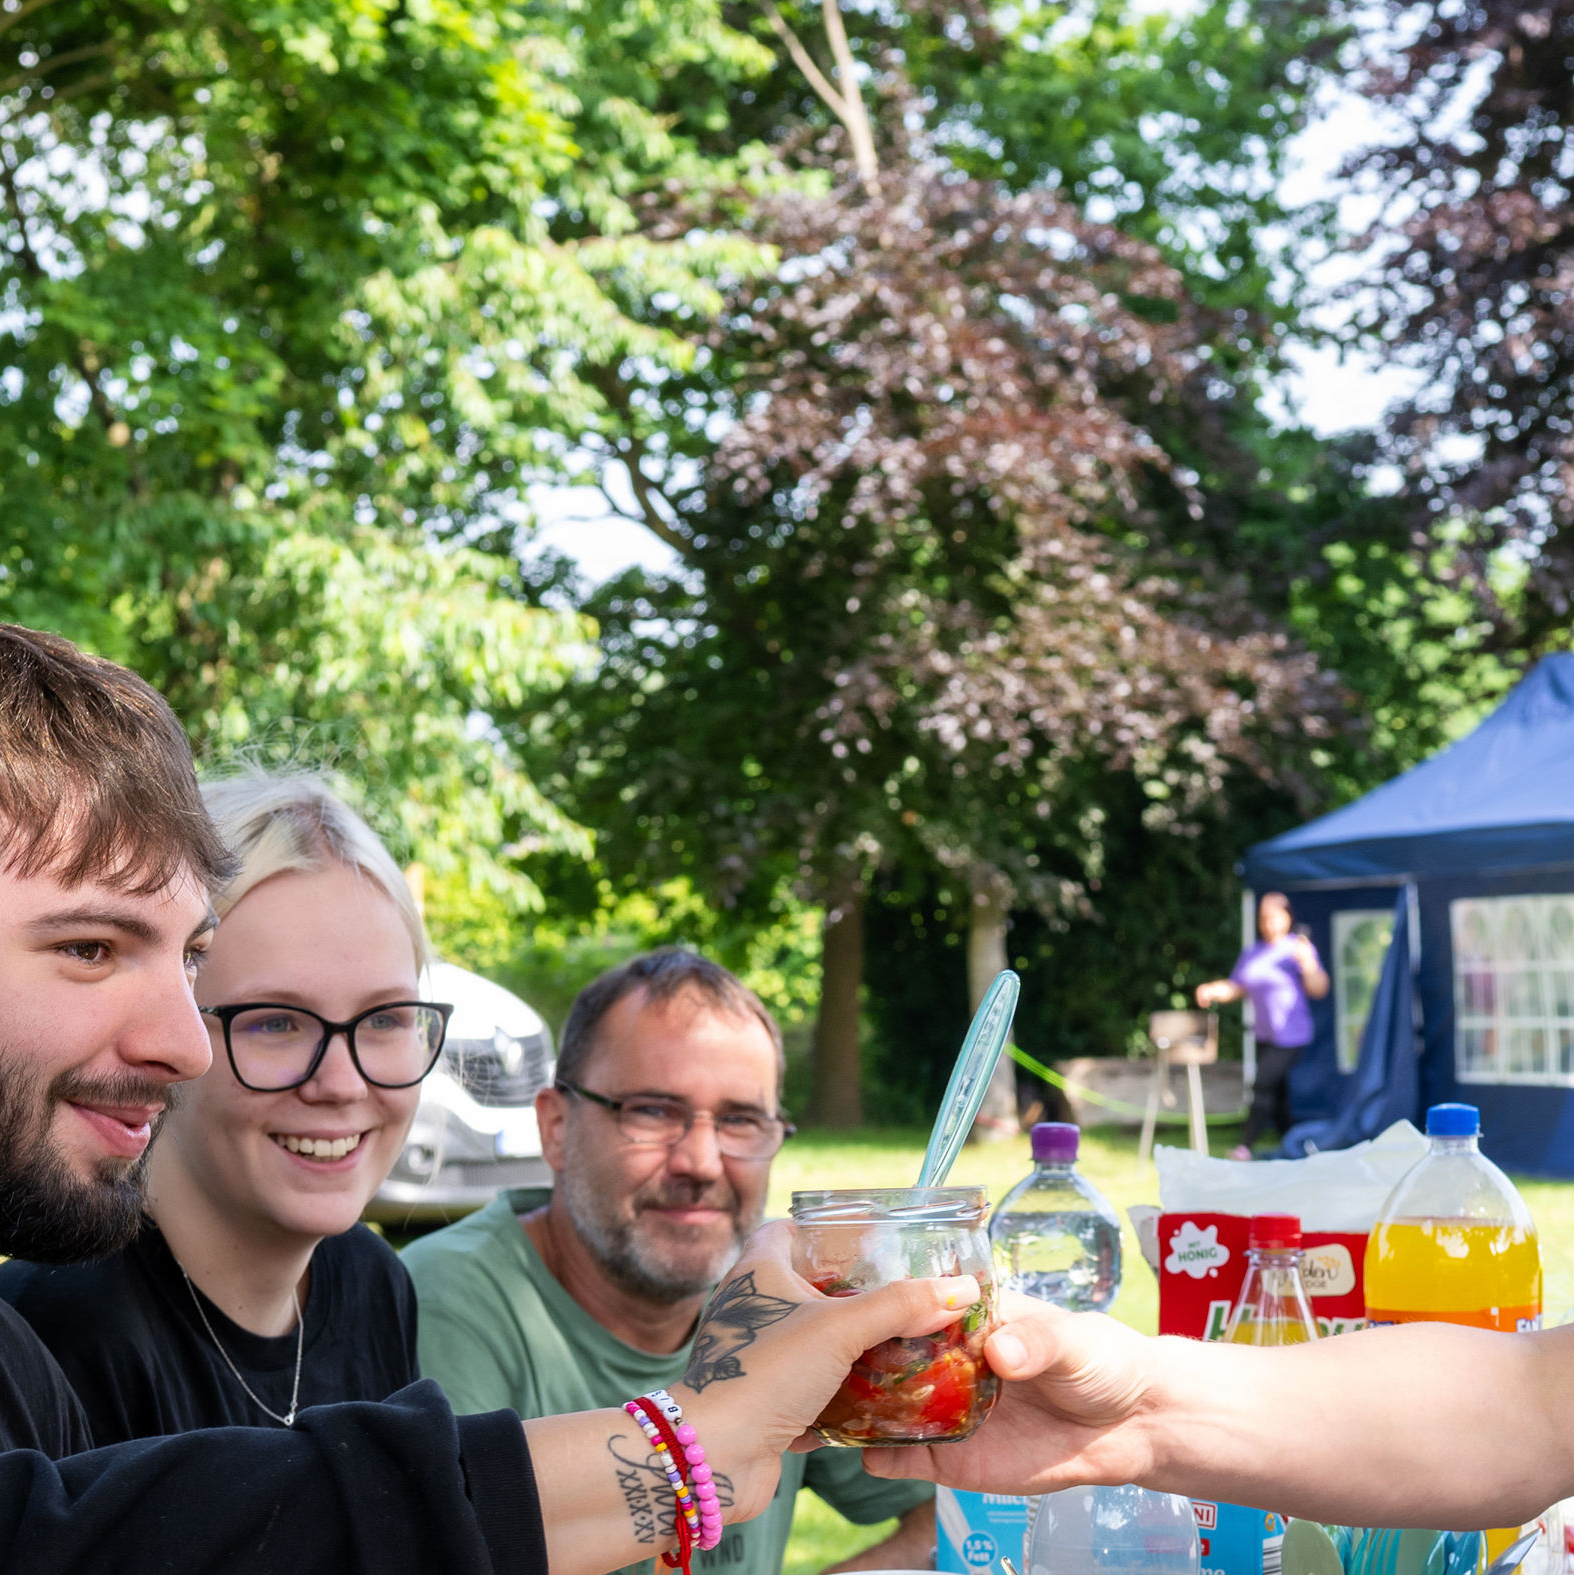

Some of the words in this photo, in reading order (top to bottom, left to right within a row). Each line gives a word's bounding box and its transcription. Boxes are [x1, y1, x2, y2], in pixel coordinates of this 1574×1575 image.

[1178, 1248, 1217, 1262] HONIG
[966, 1539, 982, 1551] 1,5
[982, 1540, 994, 1551] %
[967, 1551, 990, 1562] Fett
